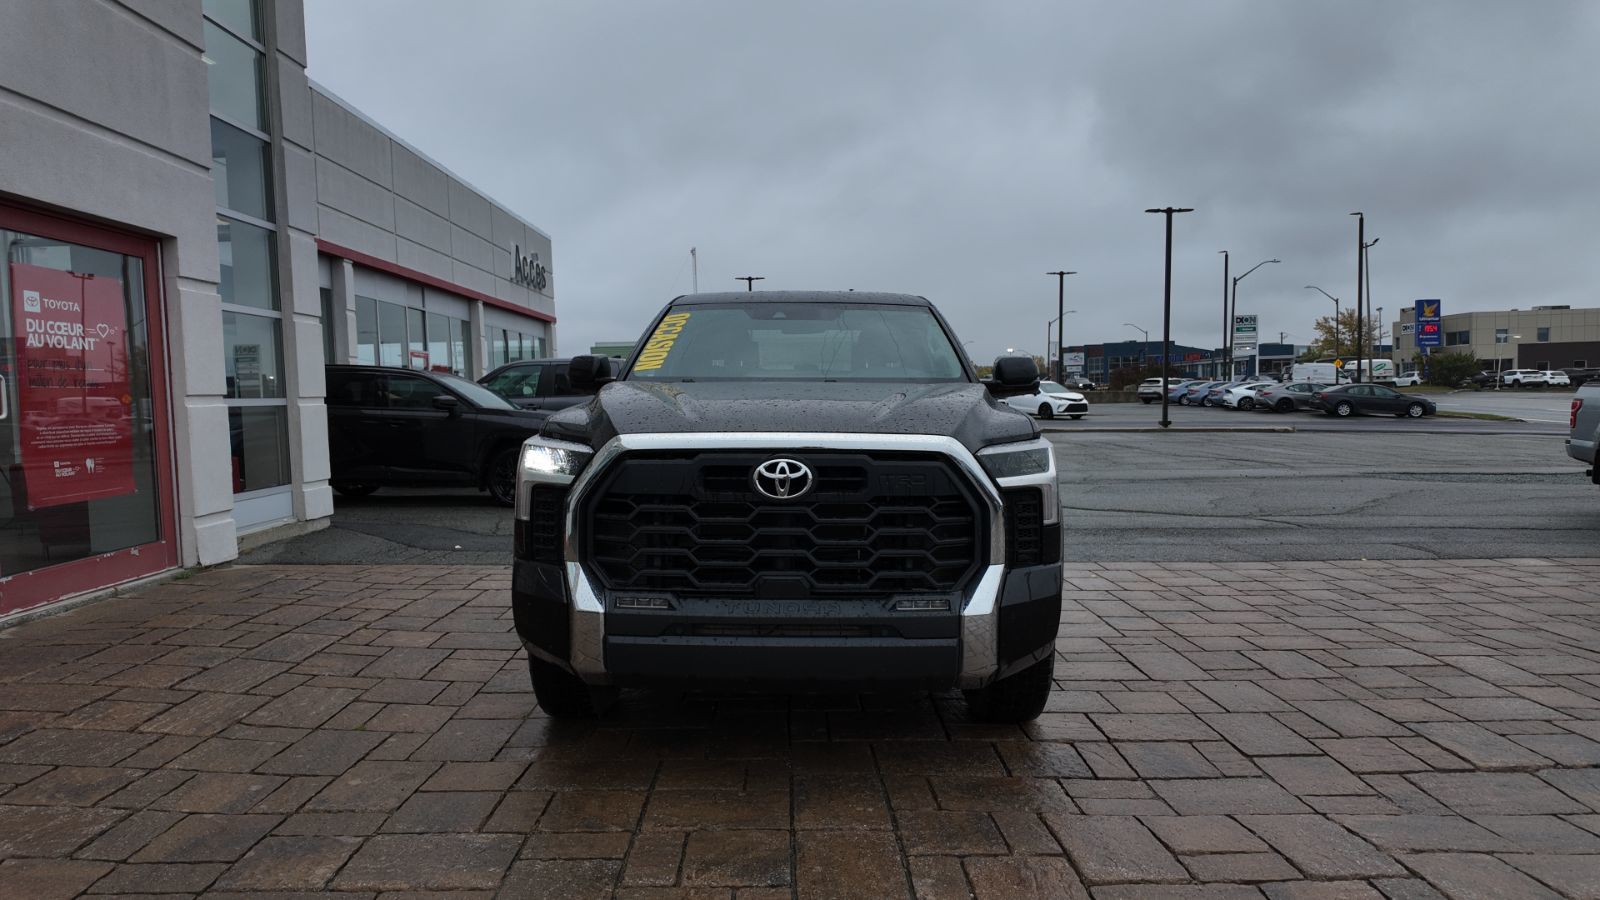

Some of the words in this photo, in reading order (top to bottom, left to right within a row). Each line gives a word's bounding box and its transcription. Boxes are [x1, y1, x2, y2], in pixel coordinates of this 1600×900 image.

[43, 298, 80, 312] TOYOTA
[26, 318, 44, 333] DU
[46, 320, 84, 336] CŒUR
[26, 333, 44, 347] AU
[46, 334, 95, 350] VOLANT
[633, 312, 691, 371] OCCASION
